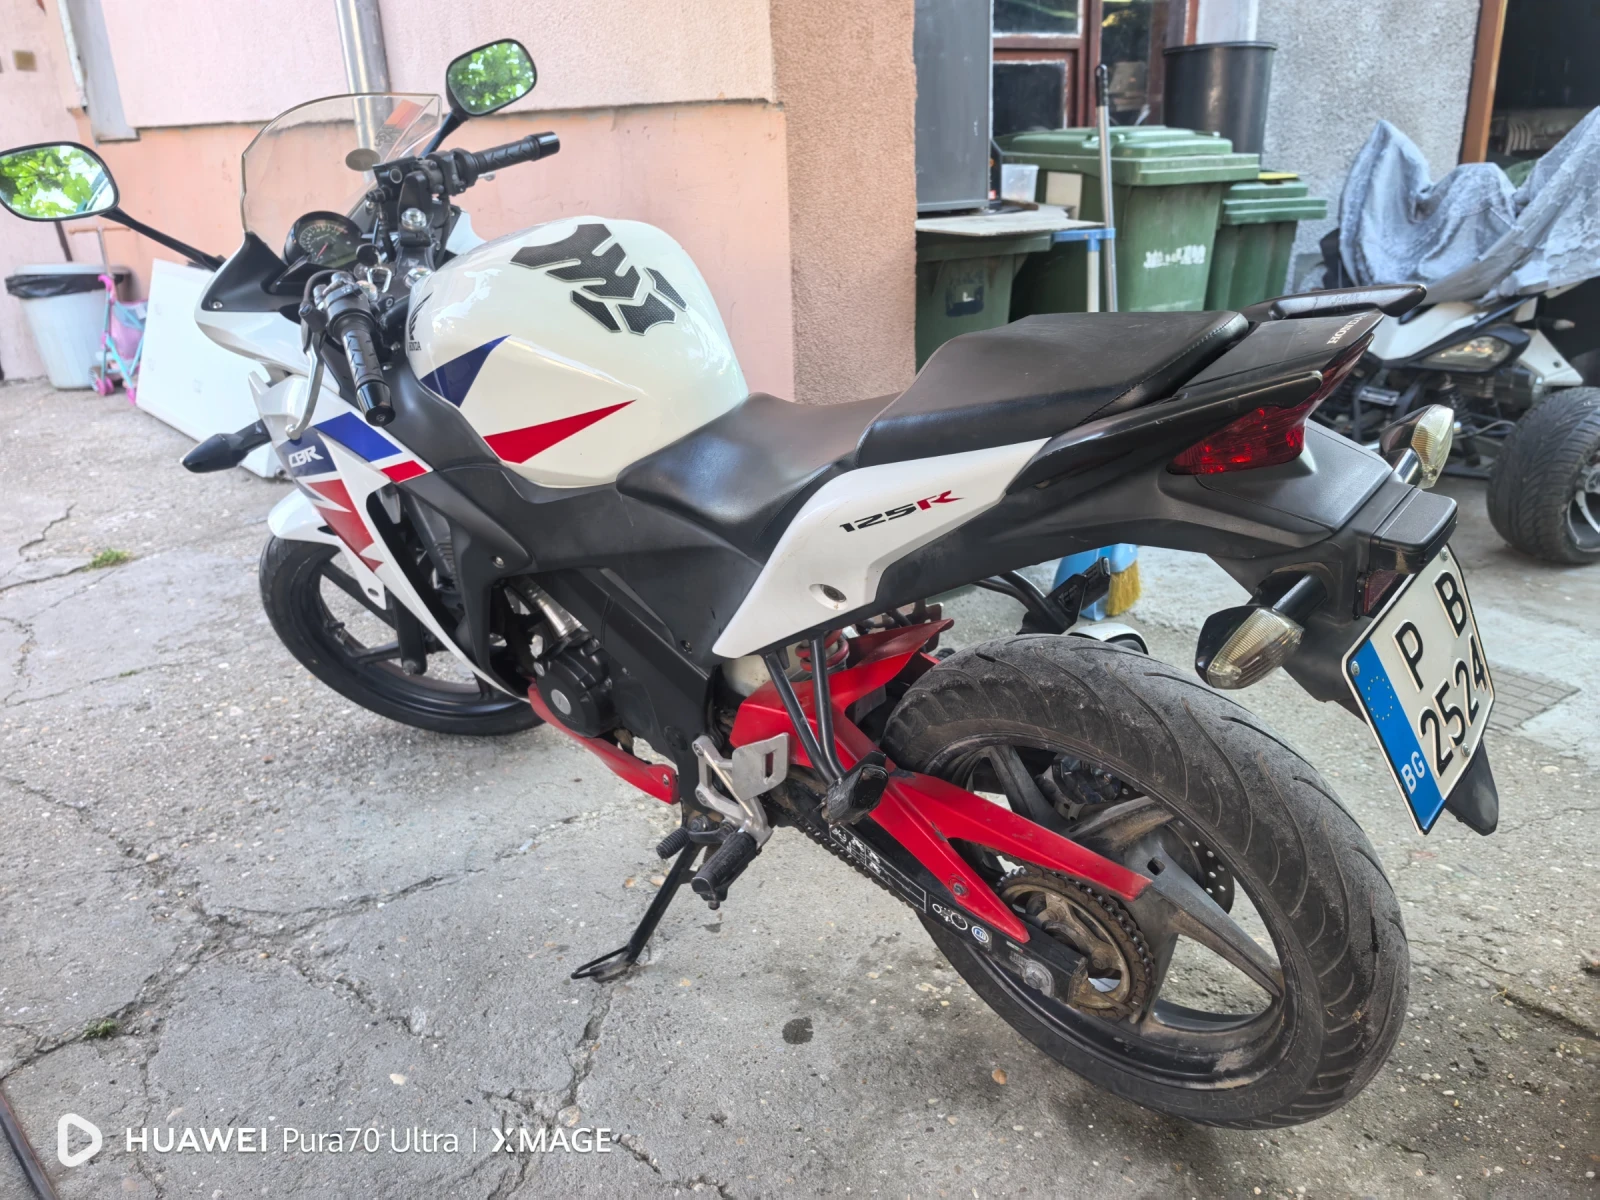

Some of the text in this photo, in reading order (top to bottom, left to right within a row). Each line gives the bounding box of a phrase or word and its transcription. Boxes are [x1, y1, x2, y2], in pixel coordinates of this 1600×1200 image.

[288, 445, 324, 468] CBR
[839, 490, 964, 532] 125R
[1393, 570, 1467, 692] P B
[1417, 633, 1487, 779] 2524
[1401, 750, 1425, 794] BG
